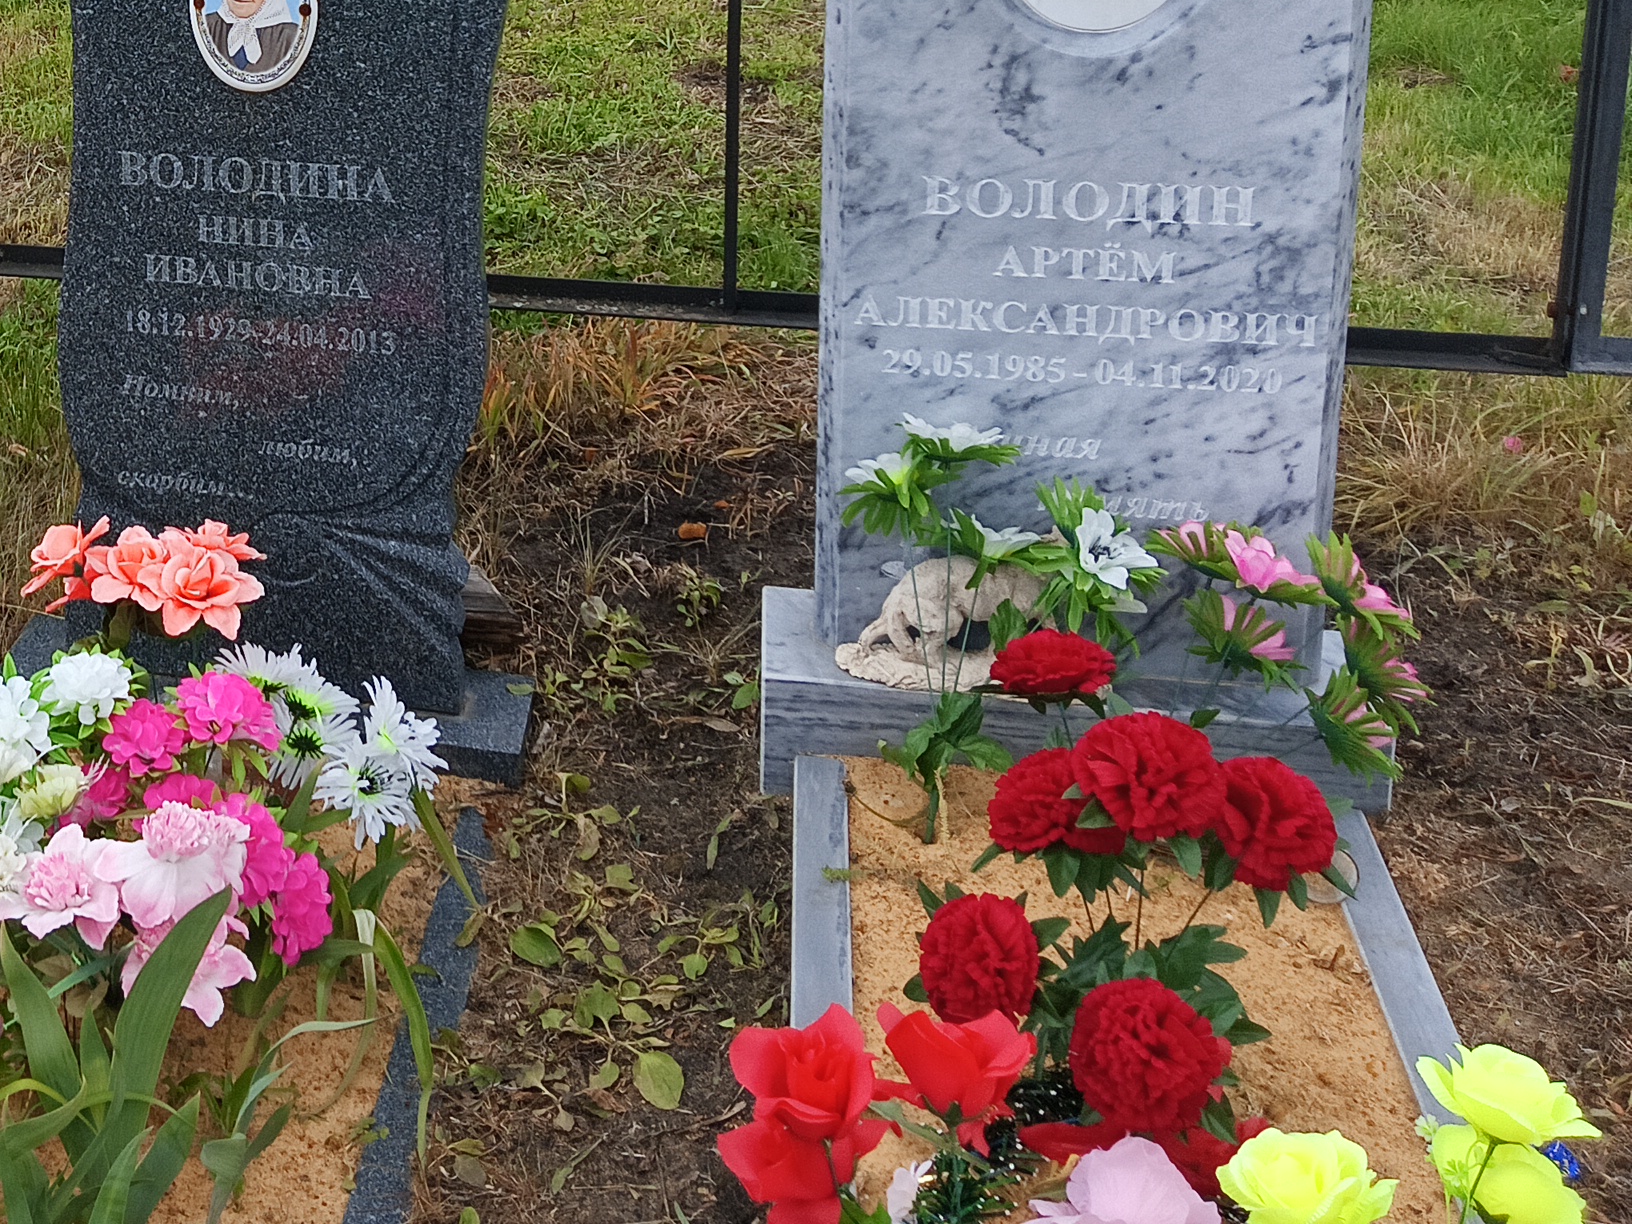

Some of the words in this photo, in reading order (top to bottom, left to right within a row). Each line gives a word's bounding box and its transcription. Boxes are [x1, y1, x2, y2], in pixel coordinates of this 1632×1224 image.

[117, 150, 397, 204] ВОЛОДИНА
[921, 175, 1256, 232] ВОЛОДИН
[197, 214, 313, 249] НИНА
[143, 254, 372, 299] ИВАНОВНА
[992, 241, 1178, 284] АРТЁМ
[853, 294, 1318, 348] АЛЕКСАНДРОВИЧ
[881, 349, 1067, 384] 29.05.1985
[1094, 359, 1284, 395] 04.11.2020
